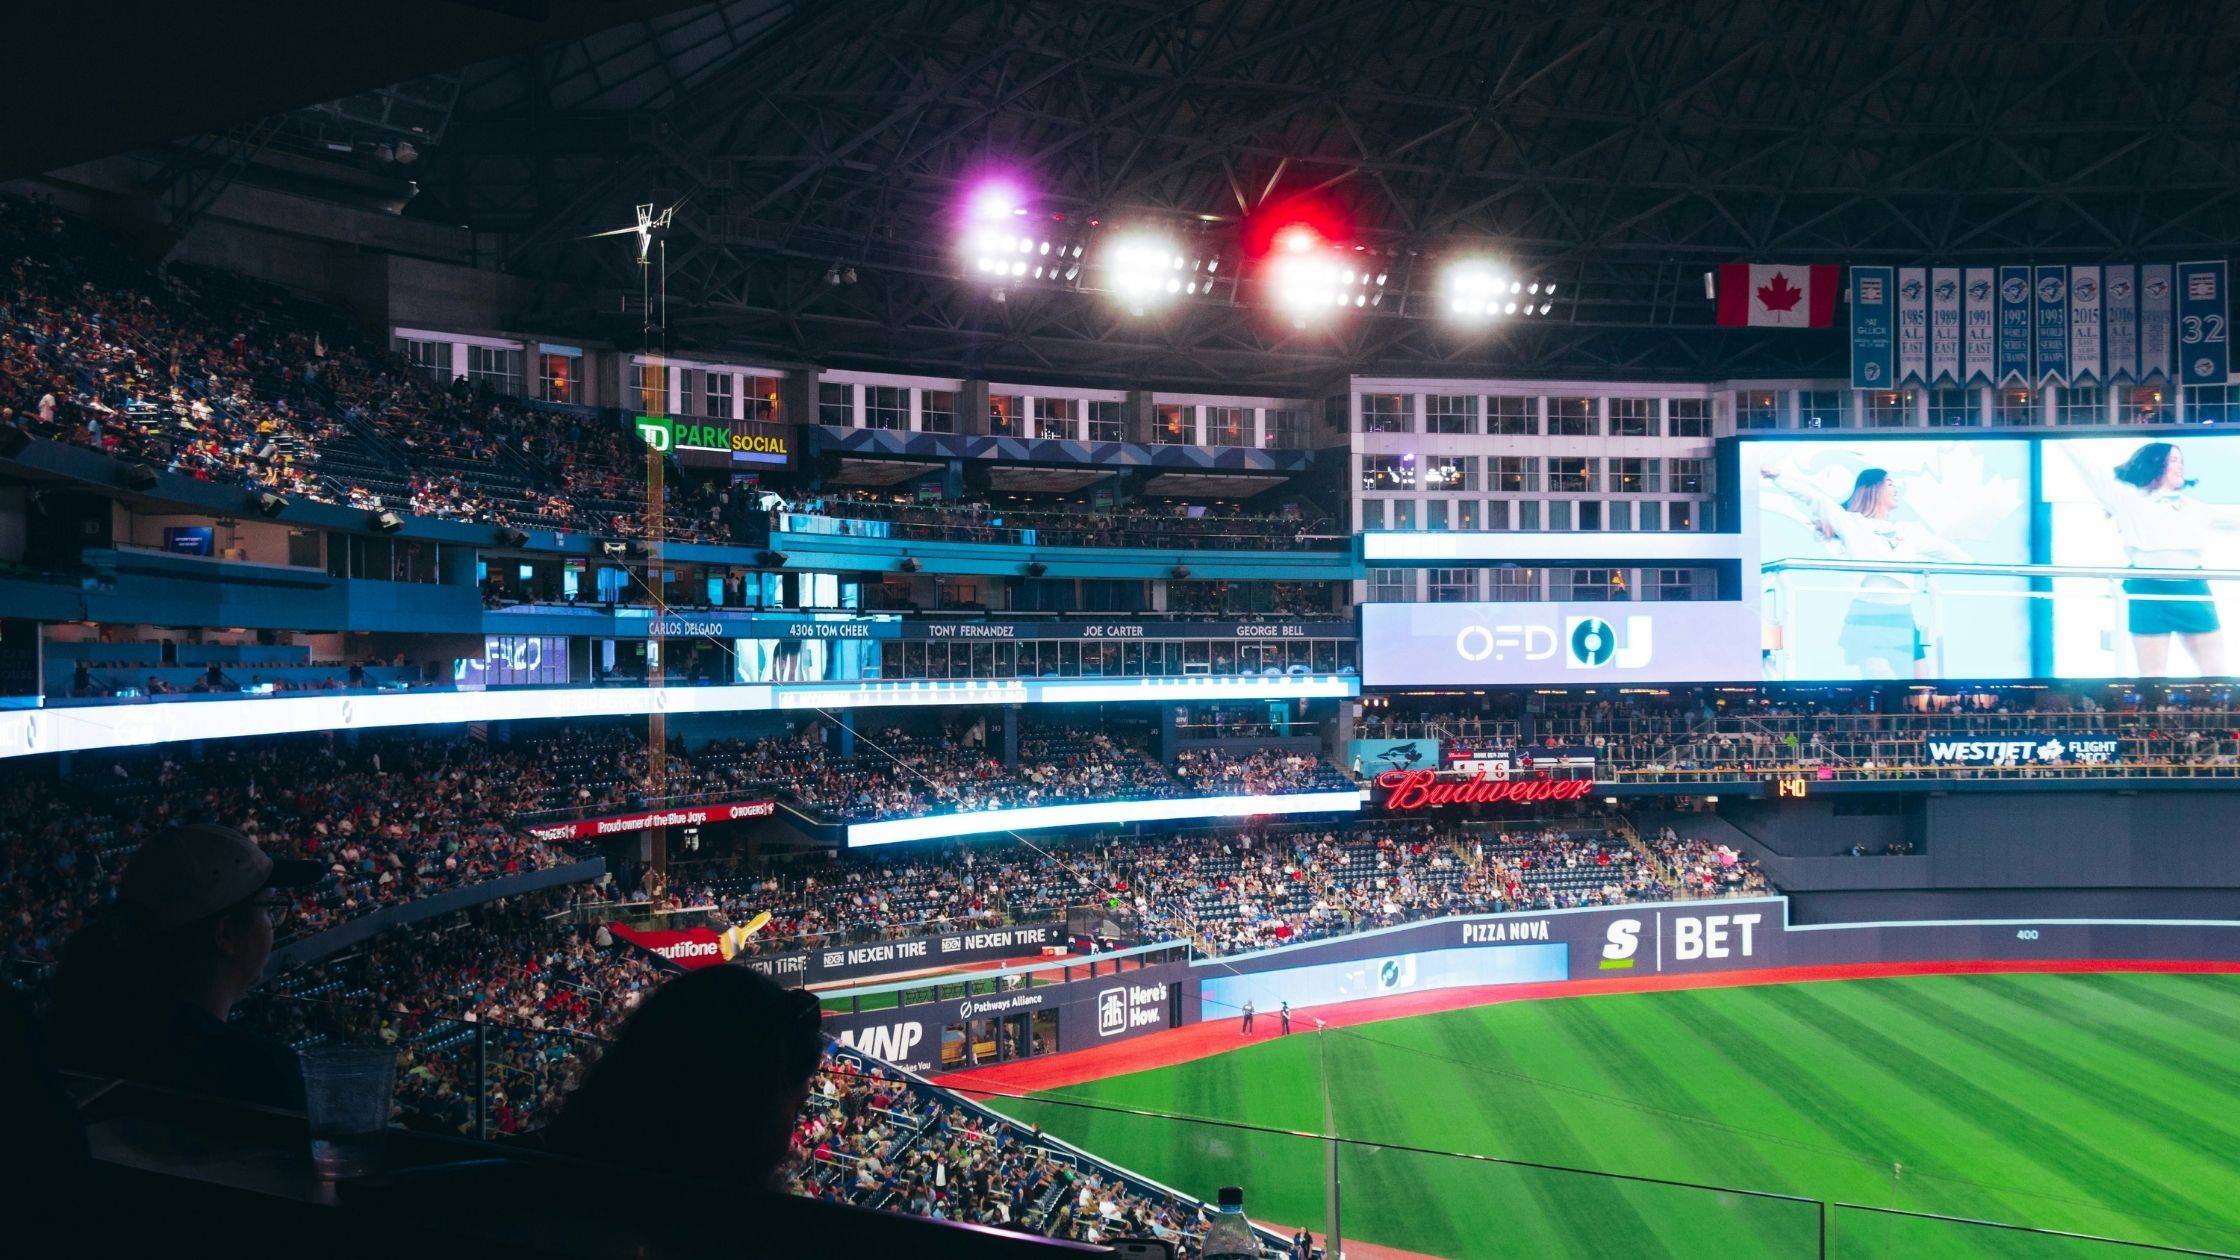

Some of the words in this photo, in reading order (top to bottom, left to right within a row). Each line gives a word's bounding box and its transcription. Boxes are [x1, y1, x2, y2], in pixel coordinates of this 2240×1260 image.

[1901, 310, 1924, 326] 1985
[1935, 310, 1958, 326] 1989
[1968, 310, 1991, 326] 1991
[2004, 310, 2027, 325] 1992
[2040, 309, 2064, 325] 1993
[2073, 308, 2099, 324] 2015
[2182, 314, 2225, 343] 32
[1902, 342, 1924, 354] EAST
[1934, 342, 1957, 354] EAST
[1968, 342, 1991, 354] EAST
[675, 424, 730, 448] PARK
[732, 435, 787, 453] SOCIAL
[649, 622, 681, 635] CARLOS
[684, 623, 723, 635] DELGADO
[790, 623, 813, 636] 4306
[816, 624, 837, 636] TOM
[839, 624, 869, 637] CHEEK
[929, 625, 956, 637] TONY
[960, 625, 1014, 637] FERNANDEZ
[1083, 626, 1103, 637] JOE
[1107, 626, 1144, 637] CARTER
[1236, 626, 1278, 637] GEORGE
[1282, 626, 1304, 636] BELL
[1456, 624, 1558, 662] OFD
[1929, 741, 2036, 764] WESTJET
[2069, 741, 2117, 753] FLIGHT
[1378, 770, 1593, 811] Budweiser
[1779, 779, 1805, 797] 1:40
[738, 804, 764, 816] ROGERS
[598, 812, 621, 833] Proud
[622, 818, 644, 830] owner
[644, 814, 653, 828] of
[653, 813, 668, 826] the
[667, 812, 686, 825] Blue
[687, 811, 706, 825] Jays
[965, 932, 1012, 950] NEXEN
[1014, 928, 1046, 944] TIRE
[1463, 923, 1506, 944] PIZZA
[1510, 921, 1550, 941] NOVA
[1602, 918, 1642, 960] S
[1675, 914, 1762, 960] BET
[2016, 930, 2039, 941] 400
[848, 947, 894, 965] NEXEN
[896, 941, 927, 958] TIRE
[776, 956, 806, 974] TIRE
[1129, 982, 1167, 1007] Here's
[973, 998, 1011, 1013] Pathways
[1011, 994, 1042, 1008] Alliance
[1129, 1007, 1160, 1028] How.
[840, 1021, 923, 1062] MNP
[918, 1061, 931, 1070] You
